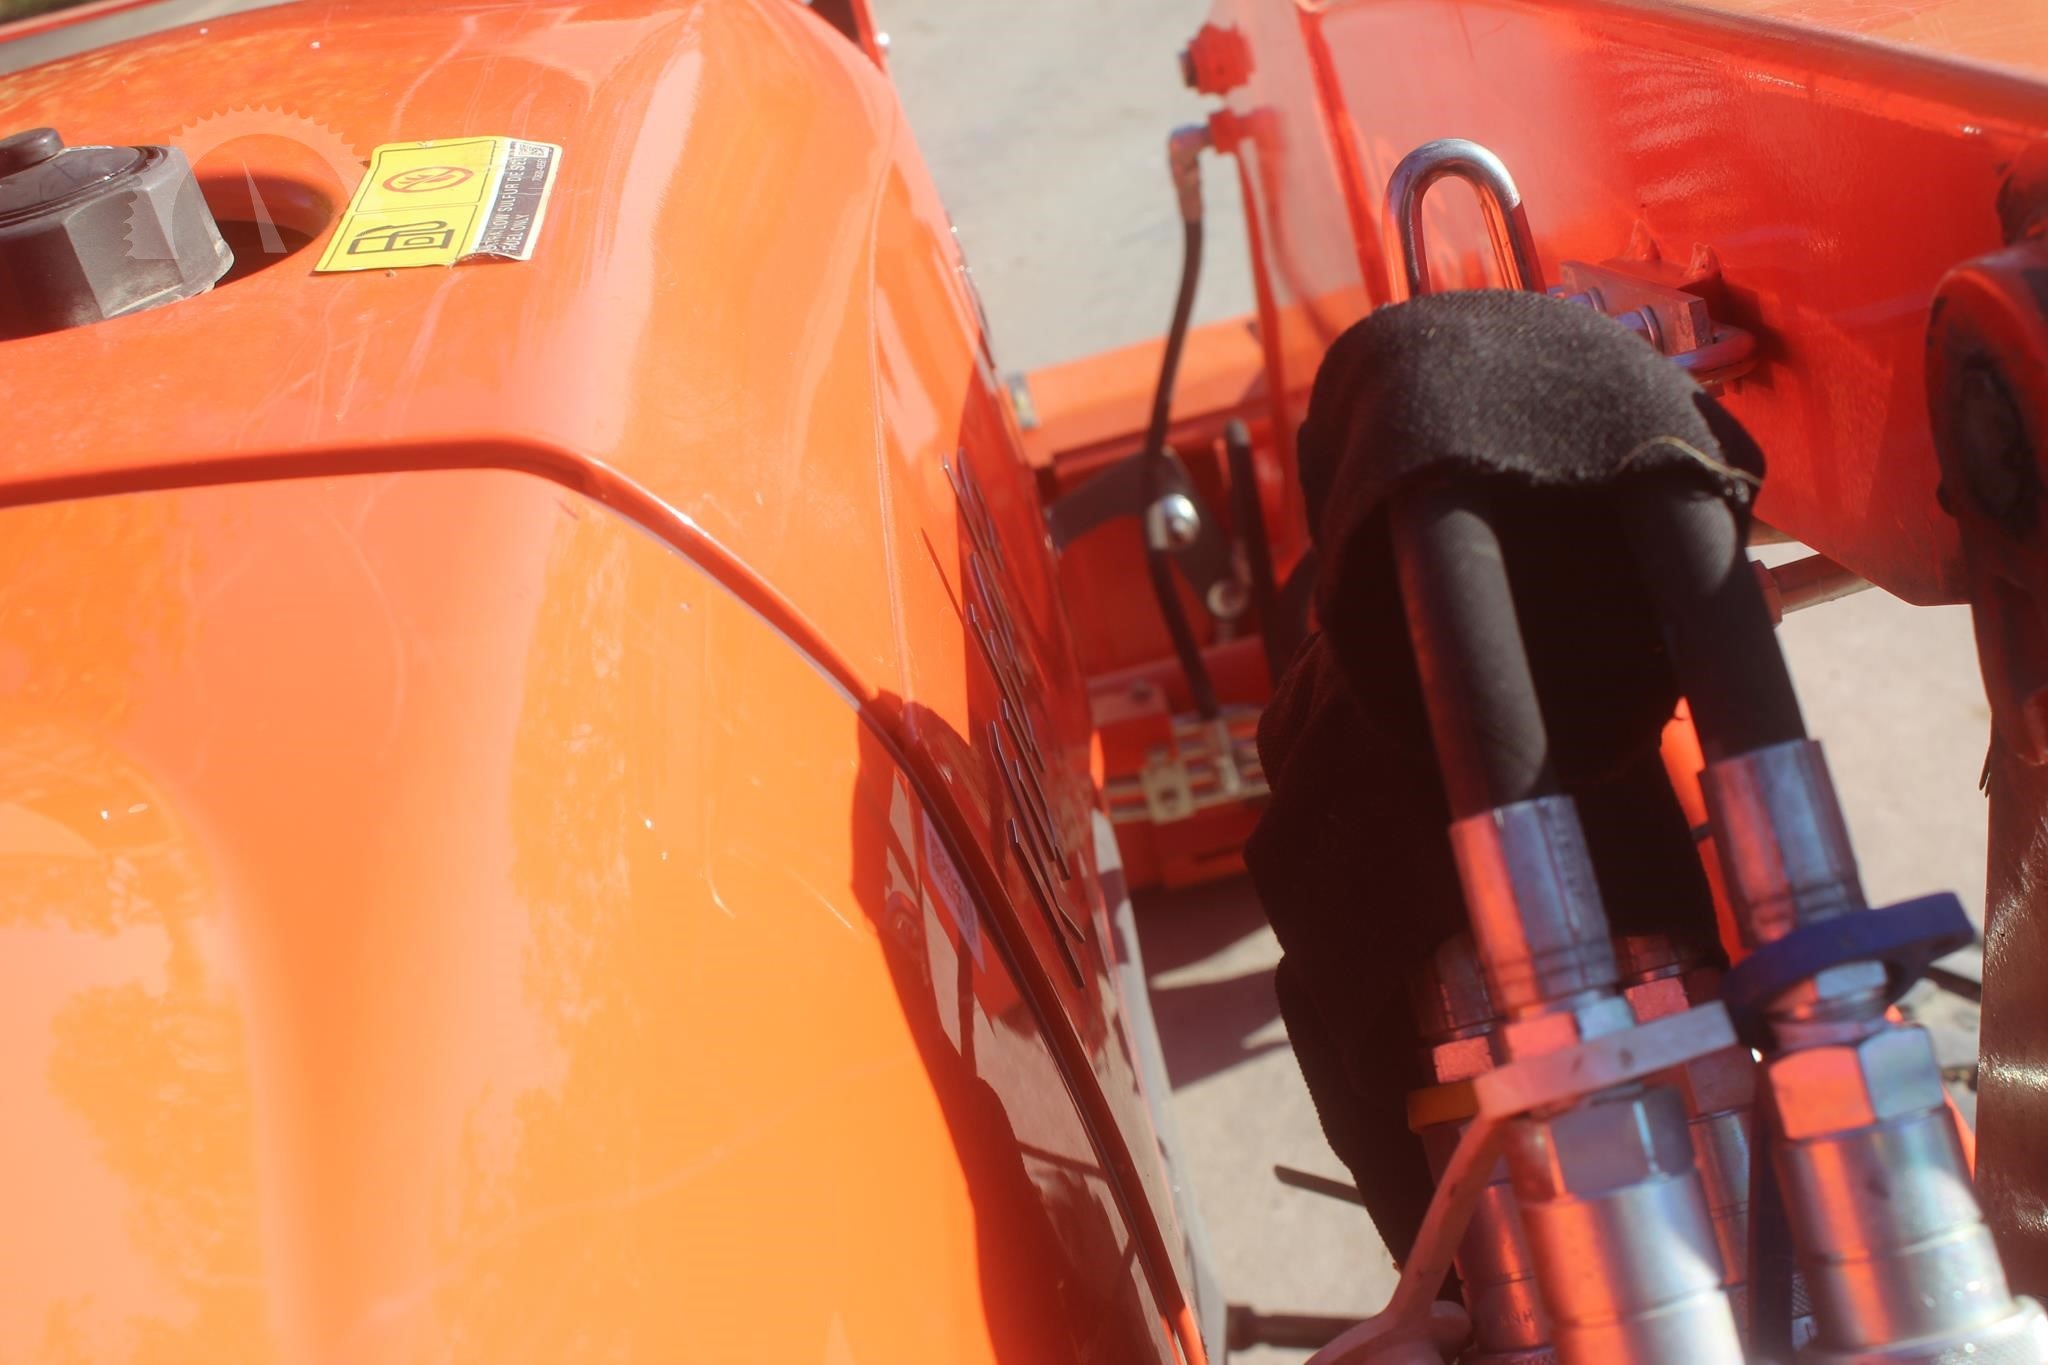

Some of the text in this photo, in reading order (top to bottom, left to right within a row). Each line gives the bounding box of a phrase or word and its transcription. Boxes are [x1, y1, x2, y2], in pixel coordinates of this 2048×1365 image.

[507, 157, 528, 182] DESEL
[498, 182, 519, 212] SULFUR
[491, 213, 510, 232] LOW
[502, 213, 530, 252] FUEL ONLY
